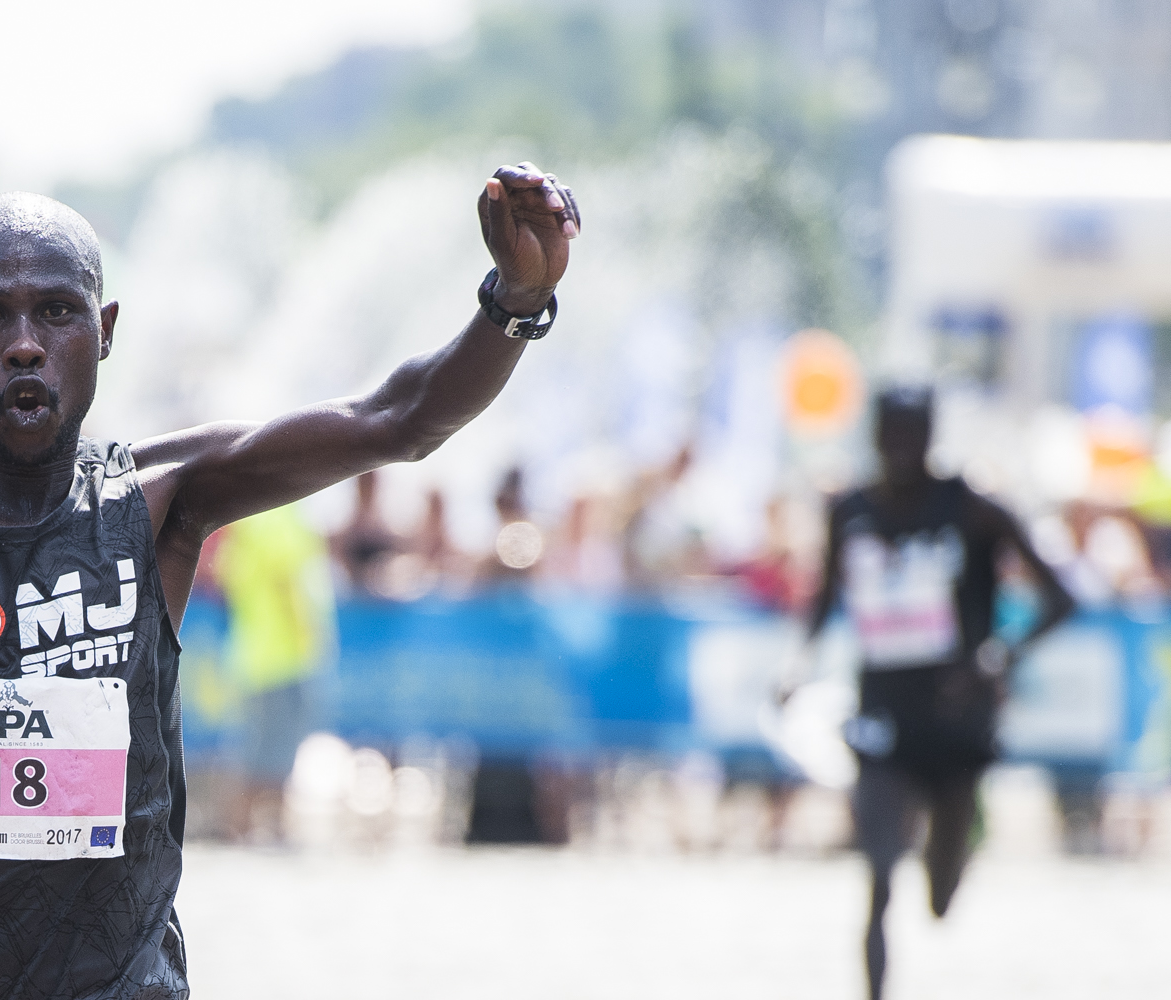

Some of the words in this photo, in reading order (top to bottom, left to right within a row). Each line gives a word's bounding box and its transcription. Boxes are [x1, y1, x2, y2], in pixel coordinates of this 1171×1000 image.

[15, 558, 137, 649] MJ
[20, 631, 134, 678] SPORT
[46, 828, 82, 845] 2017
